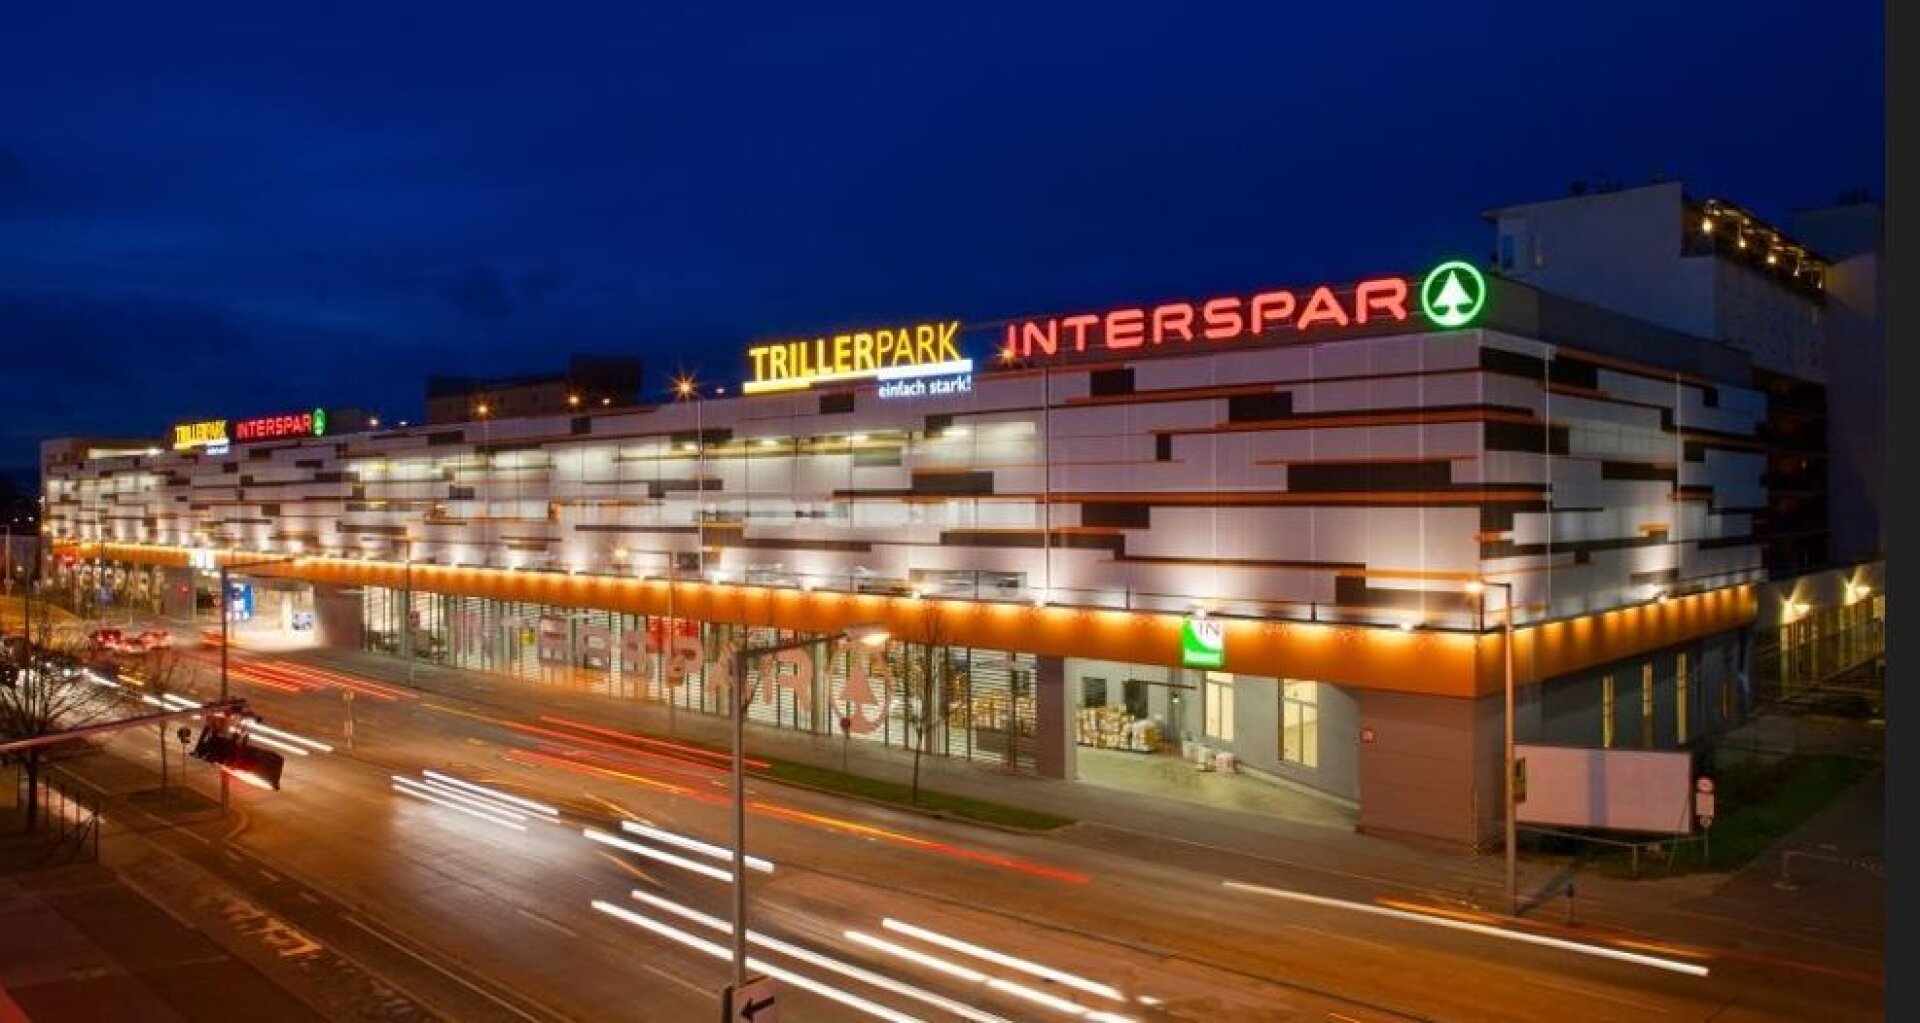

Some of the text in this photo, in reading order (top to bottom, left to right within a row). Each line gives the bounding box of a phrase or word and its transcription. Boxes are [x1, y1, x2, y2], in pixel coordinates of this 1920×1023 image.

[1004, 277, 1408, 357] INTERSPAR
[749, 321, 960, 381] TRILLERPARK
[878, 374, 972, 399] einfach stark!
[235, 413, 312, 439] INTERSPAR
